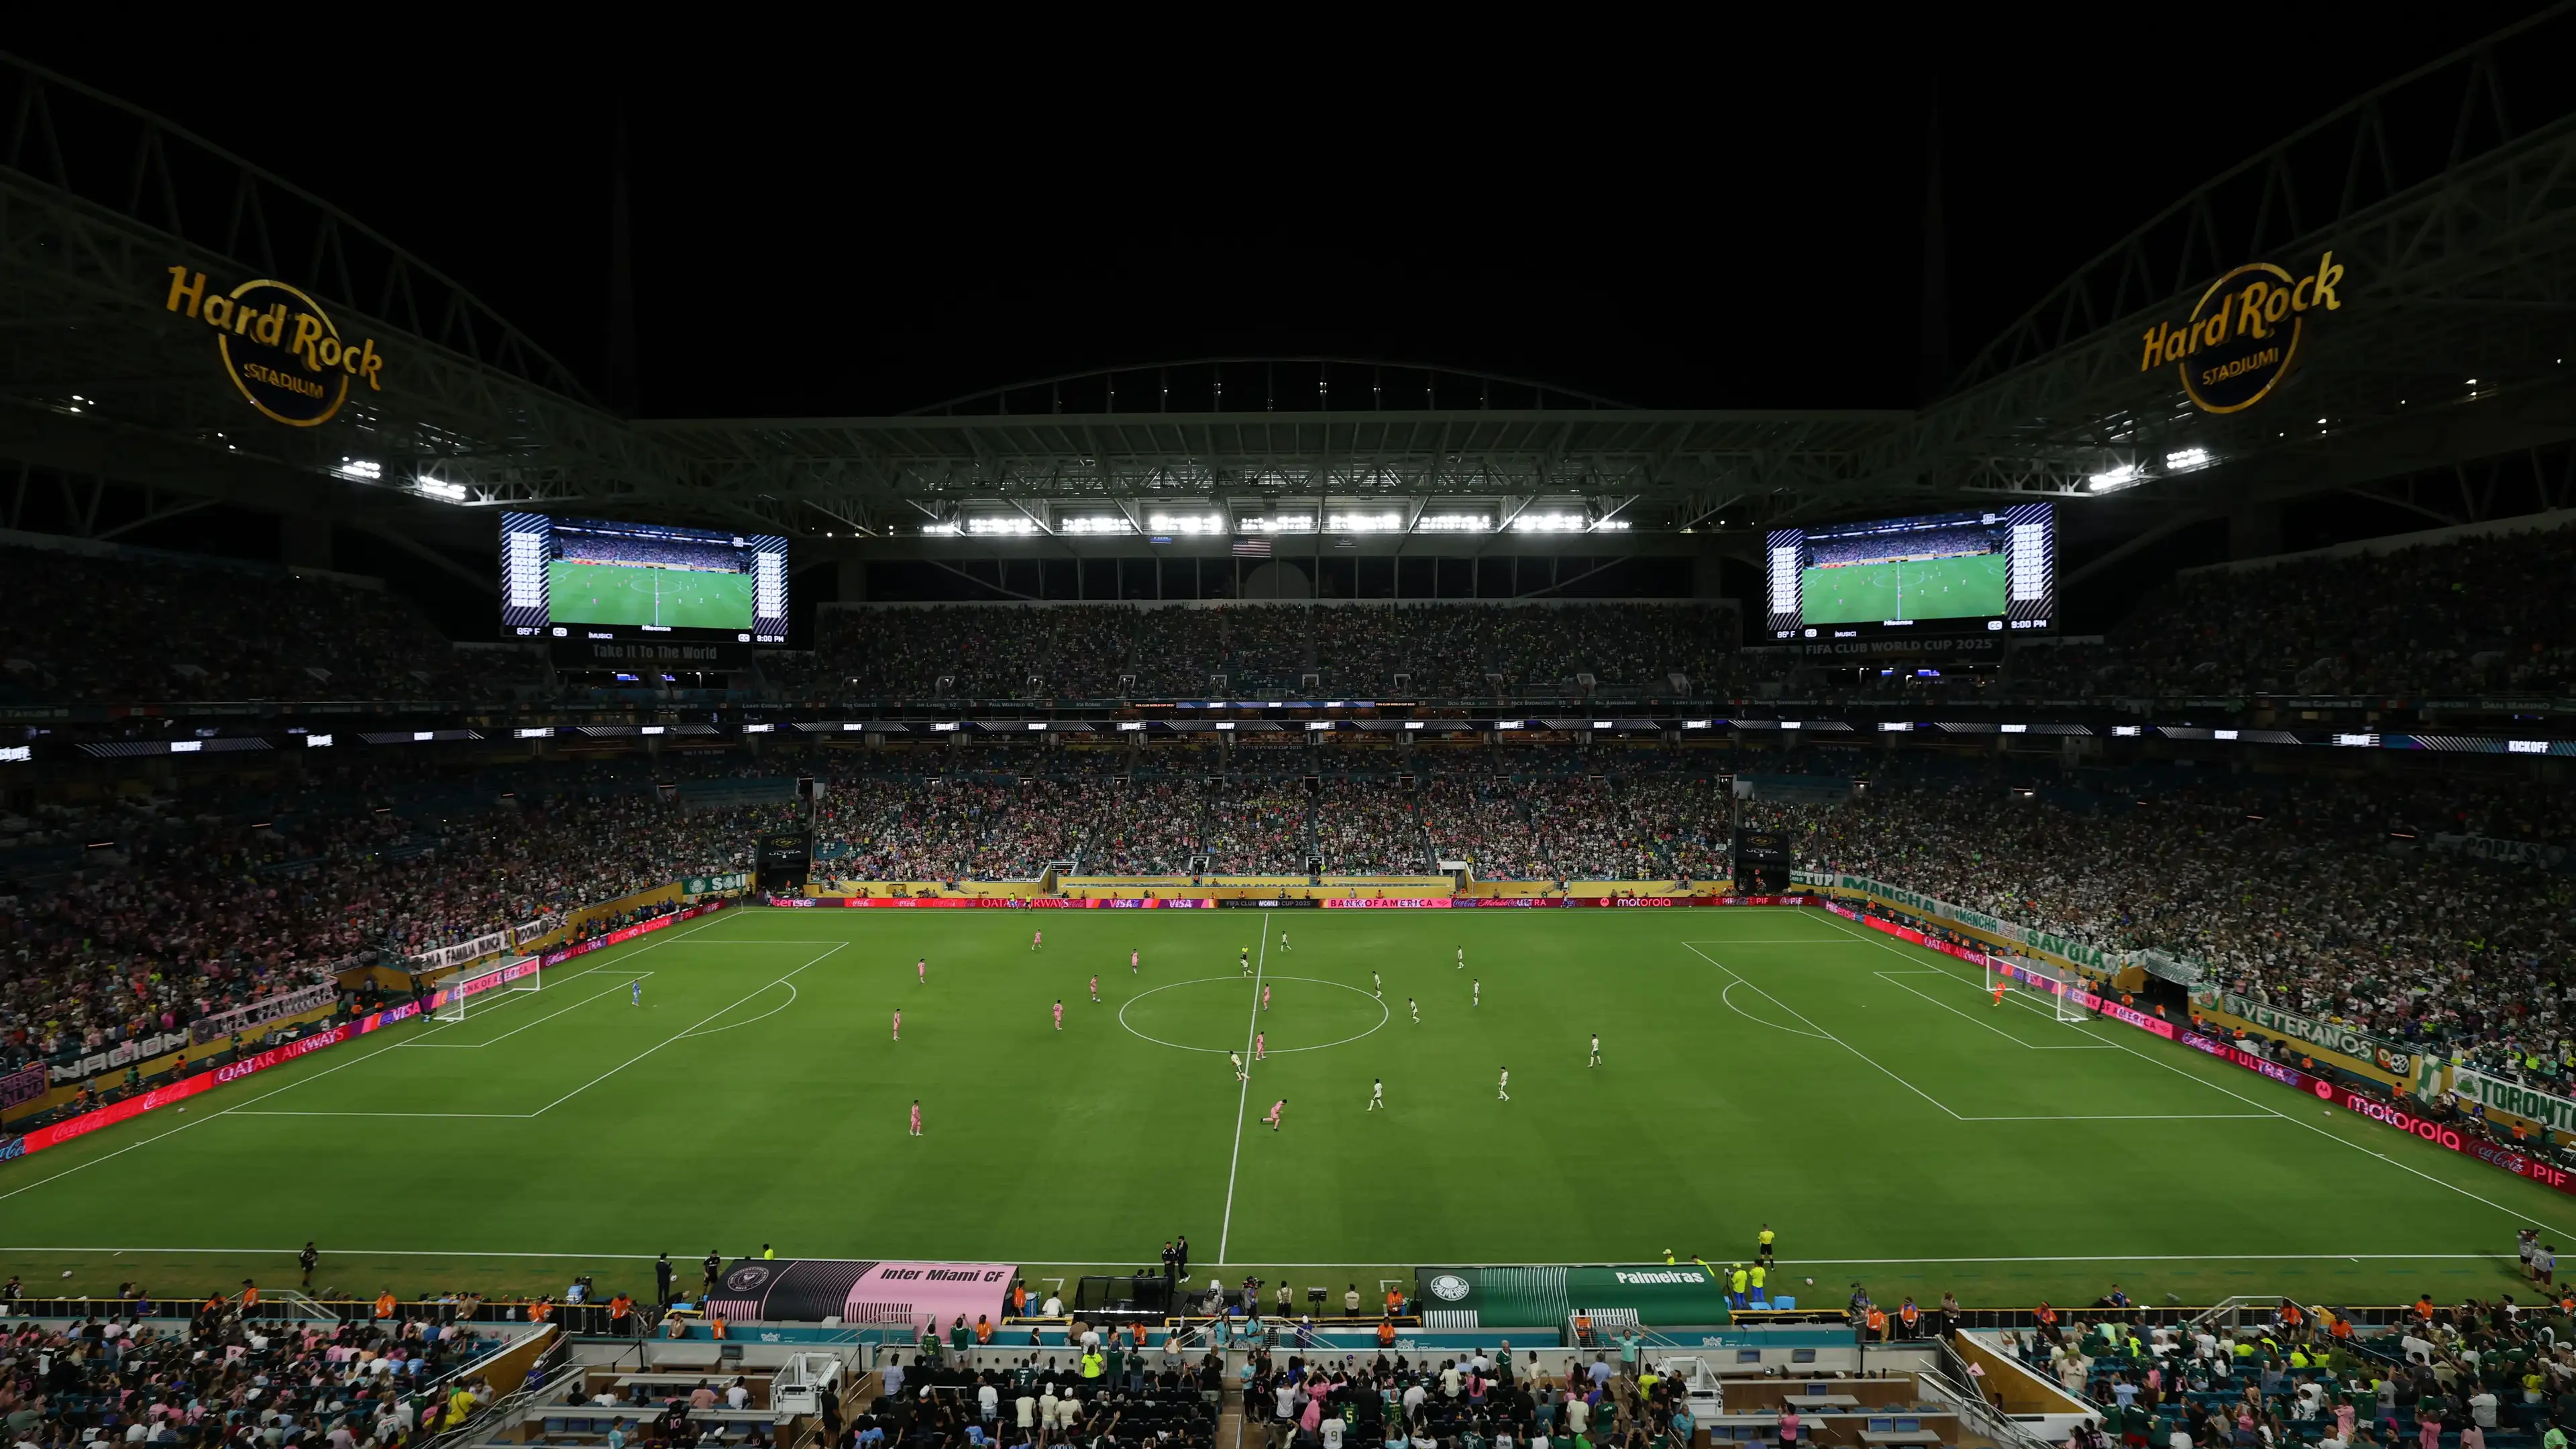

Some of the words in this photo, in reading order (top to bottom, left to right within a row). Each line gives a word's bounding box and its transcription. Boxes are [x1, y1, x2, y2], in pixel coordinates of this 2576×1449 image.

[2141, 294, 2233, 372] Hard
[2237, 251, 2345, 339] Rock
[166, 266, 287, 347] Hard
[293, 313, 383, 391] Rock
[244, 364, 323, 398] STADIUM
[2011, 620, 2031, 629] 9:00
[2033, 620, 2047, 628] PM
[593, 644, 623, 657] Take
[627, 645, 636, 657] It
[639, 645, 654, 658] To
[657, 646, 679, 658] The
[683, 646, 717, 659] World
[1806, 644, 1832, 655] FIFA
[1835, 643, 1868, 653] CLUB
[1871, 641, 1921, 652] WORLD
[1924, 640, 1953, 651] CUP
[2482, 701, 2503, 710] DAN
[2507, 701, 2551, 710] MARINO
[2509, 741, 2548, 753] KICKOFF
[1805, 872, 1833, 885] TUP
[1617, 898, 1672, 907] motorola
[1842, 876, 1937, 915] MANCHA
[1026, 899, 1068, 908] IRWAYS
[1479, 899, 1509, 907] Michelob
[1825, 900, 1856, 920] Hisense
[642, 918, 669, 932] Lenovo
[578, 941, 602, 953] ULTRA
[1924, 936, 1951, 954] QATAR
[2241, 1001, 2373, 1059] VETERANOS
[218, 1051, 276, 1083] QATAR
[282, 1028, 344, 1060] AIRWAYS
[2348, 1095, 2460, 1151] motorola
[2534, 1163, 2567, 1187] PIF
[880, 1269, 924, 1281] Inter
[928, 1269, 982, 1282] Miami
[985, 1271, 1005, 1283] CF
[1615, 1271, 1705, 1284] Palmeiras
[1434, 1284, 1467, 1299] PALMEIRAS
[1346, 1409, 1353, 1423] 5
[669, 1417, 682, 1430] 10
[751, 1438, 761, 1446] 10
[969, 1436, 977, 1444] 10
[1331, 1432, 1338, 1441] 9
